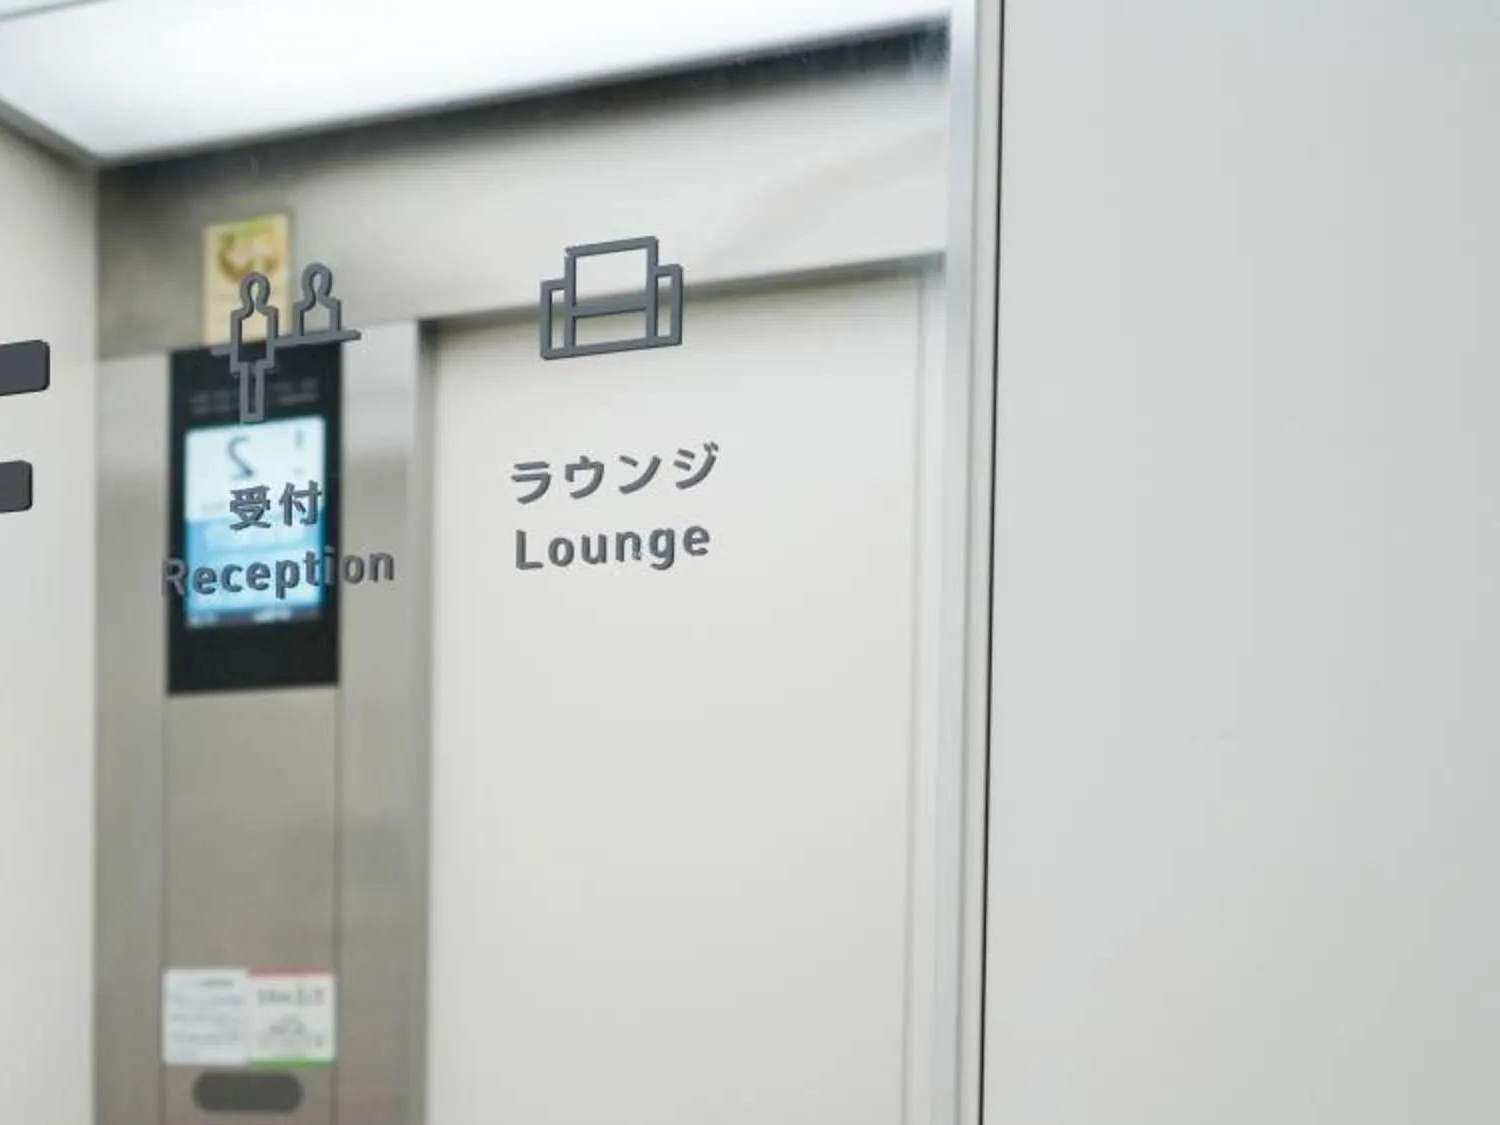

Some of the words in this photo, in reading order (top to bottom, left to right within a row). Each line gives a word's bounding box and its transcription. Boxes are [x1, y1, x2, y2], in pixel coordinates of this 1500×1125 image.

[511, 442, 718, 504] ラウンジ
[228, 481, 322, 531] 受付
[515, 525, 710, 571] Lounge
[162, 551, 395, 598] Reception
